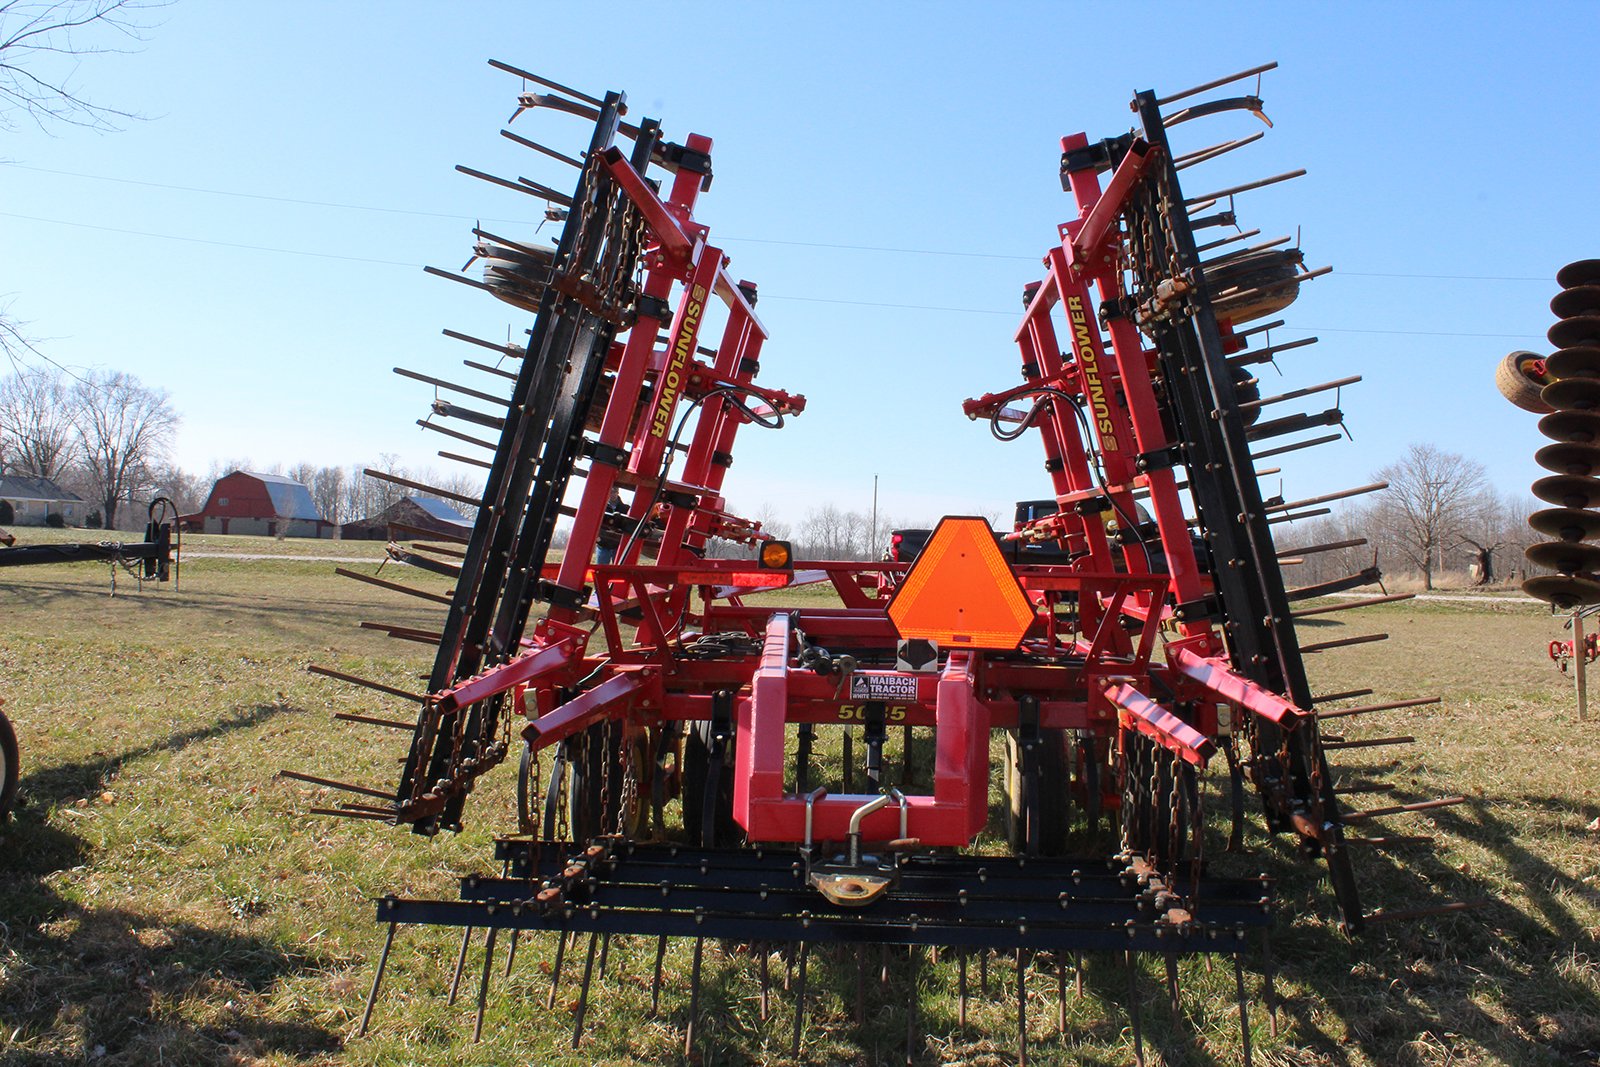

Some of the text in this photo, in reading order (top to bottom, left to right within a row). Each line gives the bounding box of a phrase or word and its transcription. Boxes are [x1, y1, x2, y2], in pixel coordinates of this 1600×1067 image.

[651, 301, 701, 438] SUNFLOWER
[1068, 296, 1113, 434] SUNFLOWER
[870, 676, 915, 686] MAIBACH
[870, 685, 915, 694] TRACTOR
[838, 705, 907, 720] 505
